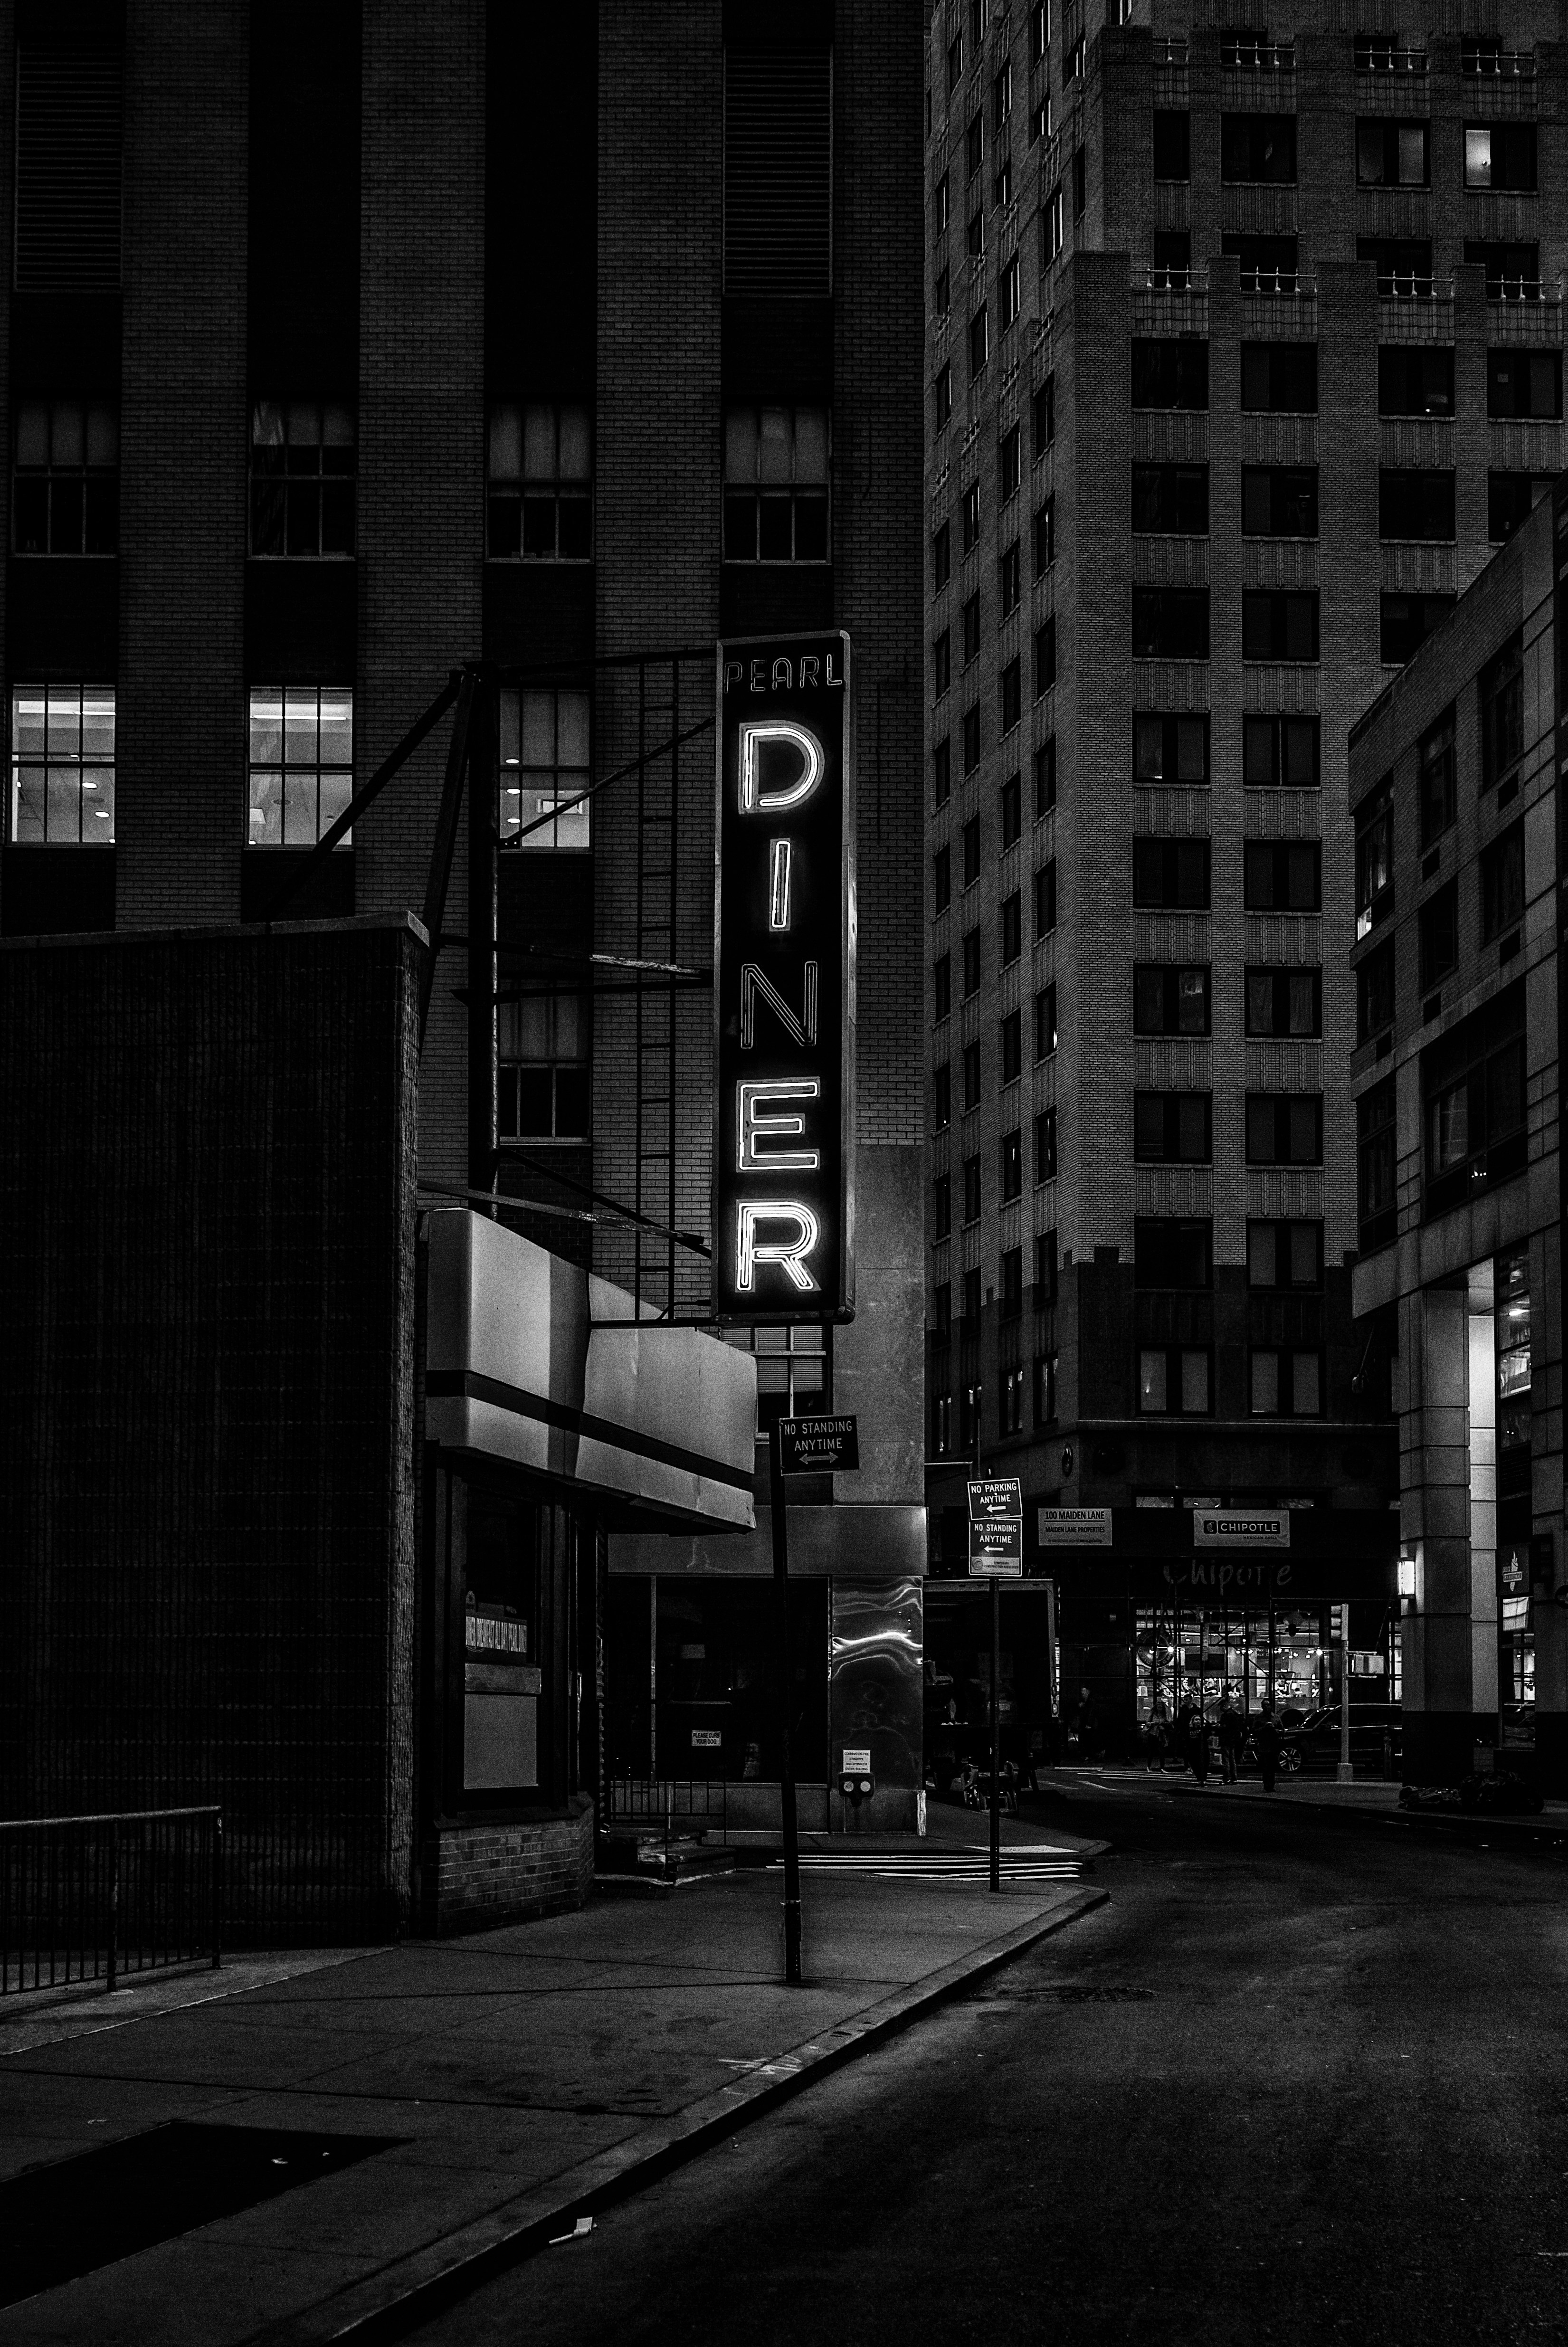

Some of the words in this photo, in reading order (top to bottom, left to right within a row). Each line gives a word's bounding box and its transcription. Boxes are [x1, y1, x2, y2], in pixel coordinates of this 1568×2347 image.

[724, 654, 843, 694] PEARL
[734, 720, 826, 1292] DINER
[785, 1424, 796, 1435] NO
[802, 1421, 852, 1434] STANDING
[794, 1438, 843, 1451] ANYTIME
[971, 1485, 982, 1493] NO
[985, 1482, 1017, 1492] PARKING
[980, 1494, 1011, 1504] ANYTIME
[1045, 1511, 1057, 1520] 100
[1059, 1511, 1086, 1520] MAIDEN
[1088, 1511, 1105, 1520] LANE
[986, 1524, 1017, 1532] STANDING
[1220, 1523, 1278, 1532] CHIPOTLE
[979, 1535, 1012, 1543] ANYTIME
[1163, 1559, 1292, 1596] Chipote
